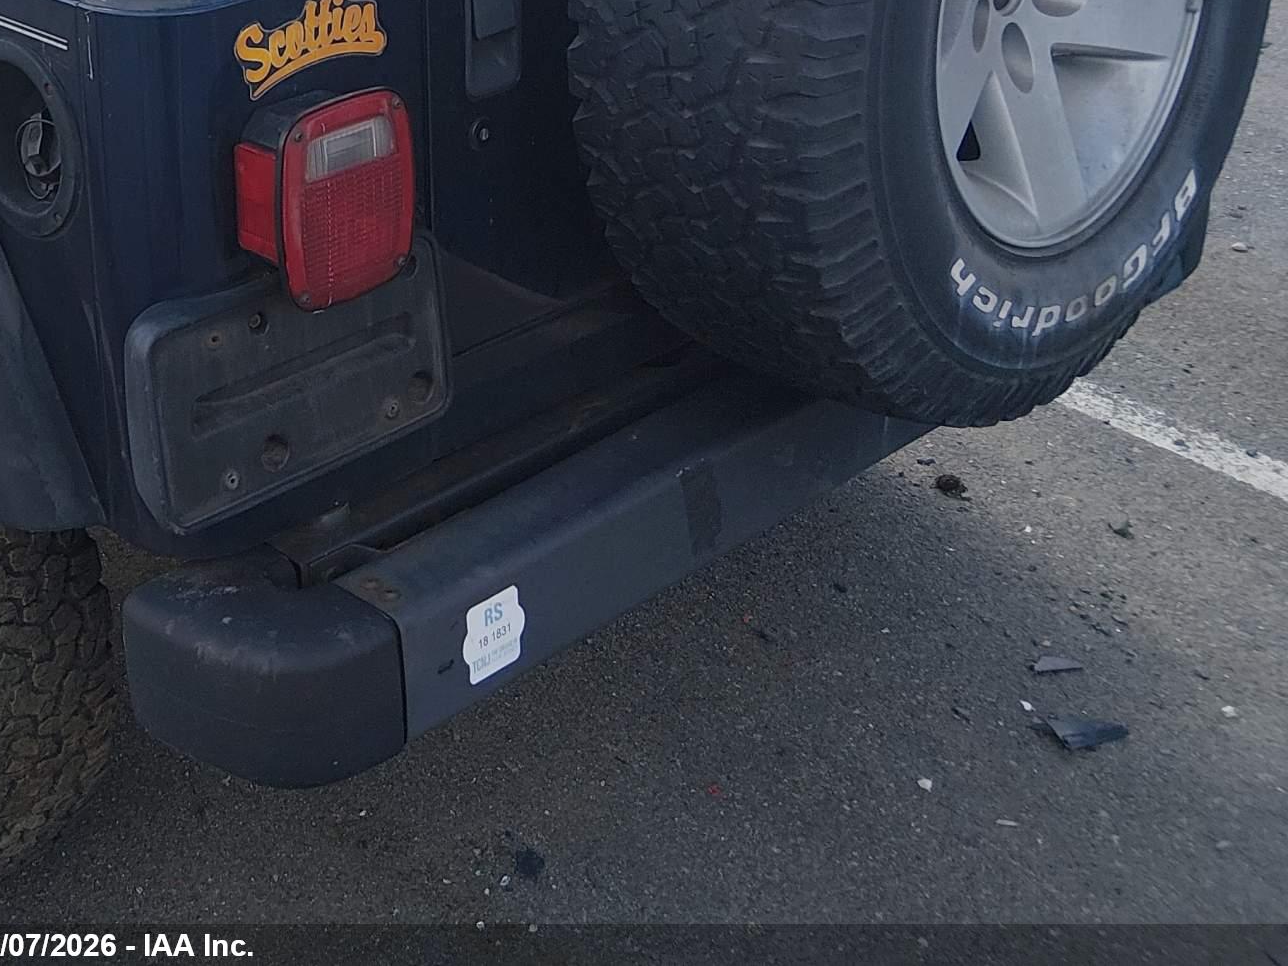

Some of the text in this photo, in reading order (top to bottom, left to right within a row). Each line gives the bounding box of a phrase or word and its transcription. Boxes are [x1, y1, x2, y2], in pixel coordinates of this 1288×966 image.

[950, 169, 1198, 337] BFGoodrich
[483, 601, 504, 627] RS
[479, 635, 489, 650] 18
[491, 621, 511, 642] 1831
